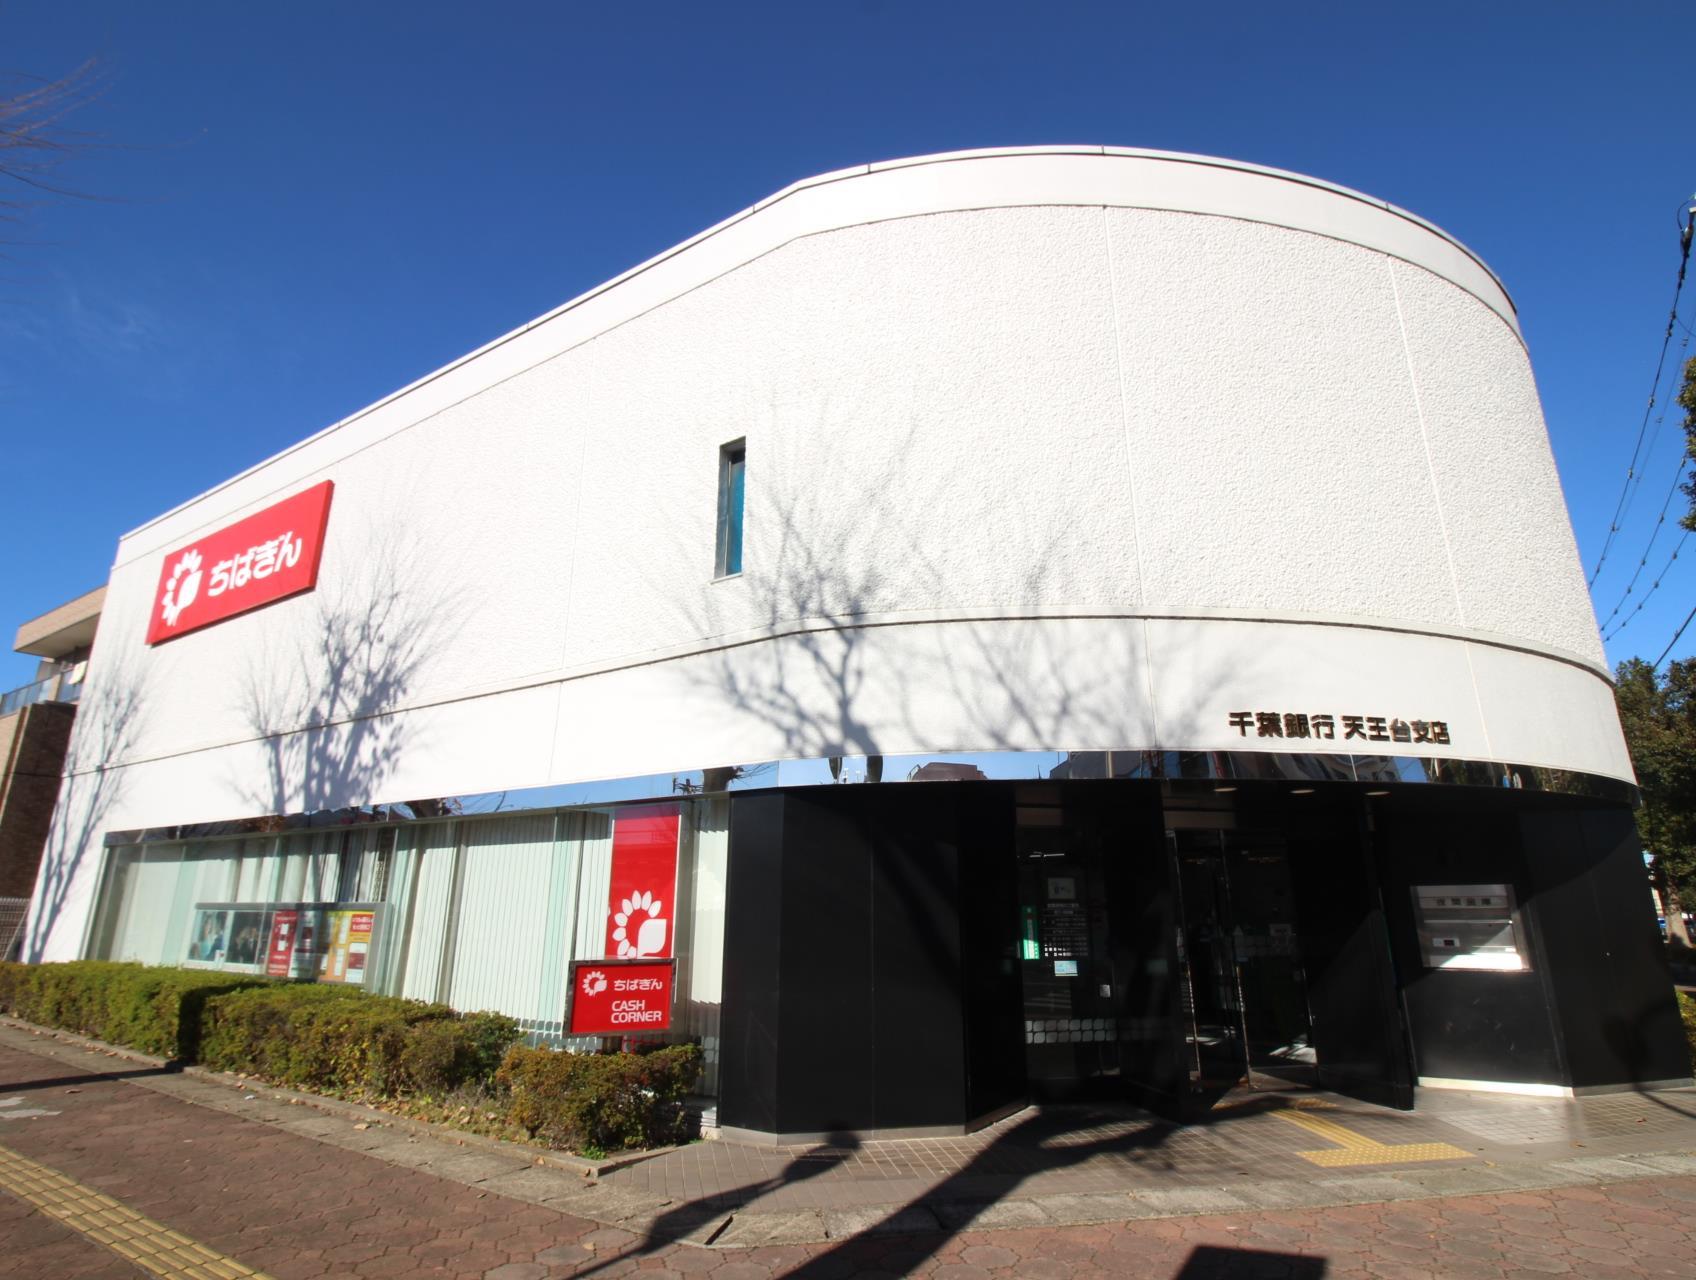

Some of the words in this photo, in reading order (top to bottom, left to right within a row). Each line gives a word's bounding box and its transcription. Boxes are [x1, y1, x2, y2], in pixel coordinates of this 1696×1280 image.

[208, 531, 302, 597] ちばぎん
[1229, 711, 1335, 740] 千葉銀行
[1341, 714, 1451, 745] 天王台支店
[613, 978, 663, 991] ちばぎん
[611, 1000, 645, 1011] CASH
[611, 1011, 662, 1023] CORNER
